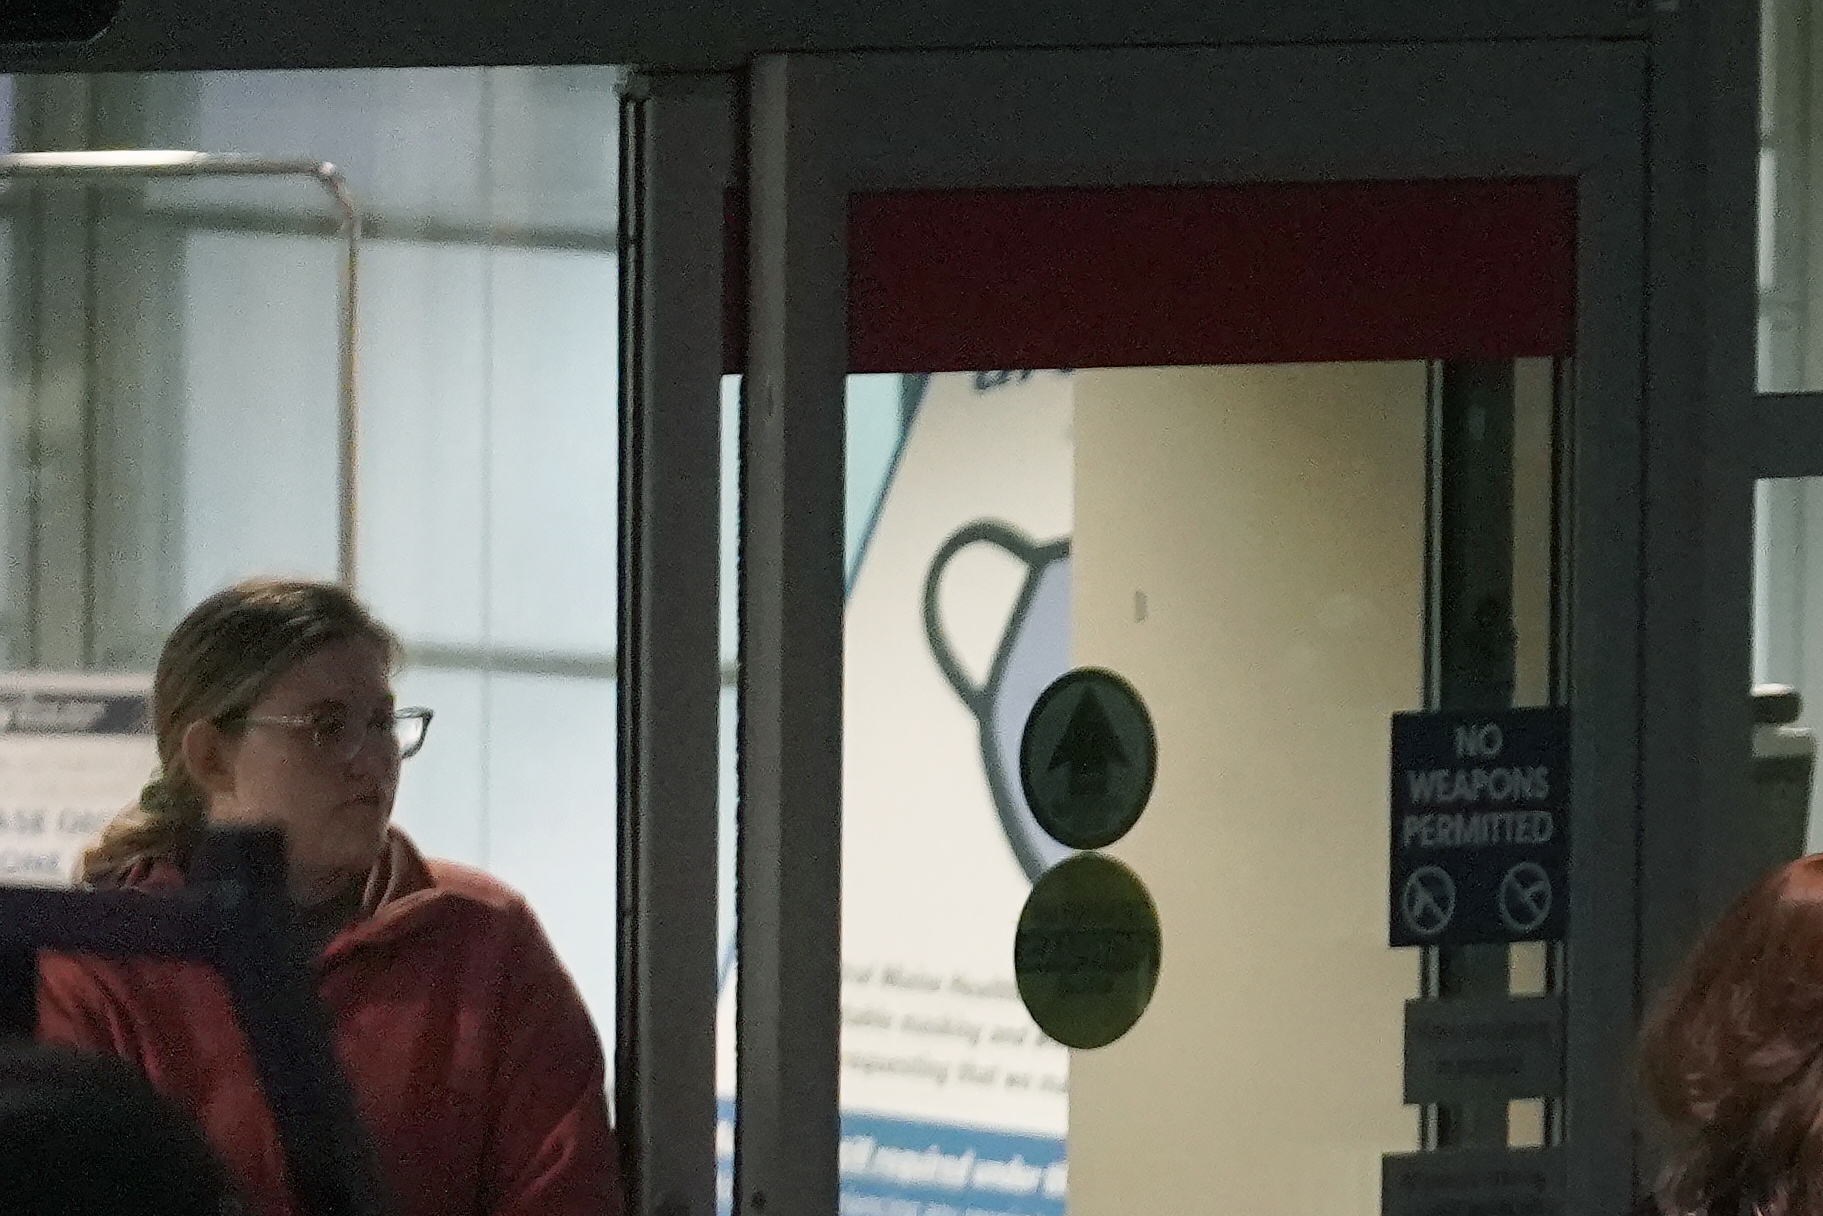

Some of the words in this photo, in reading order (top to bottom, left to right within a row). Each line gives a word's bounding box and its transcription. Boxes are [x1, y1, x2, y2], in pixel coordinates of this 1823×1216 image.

[1454, 722, 1503, 758] NO
[1406, 766, 1549, 803] WEAPONS
[1402, 810, 1554, 846] PERMITTED
